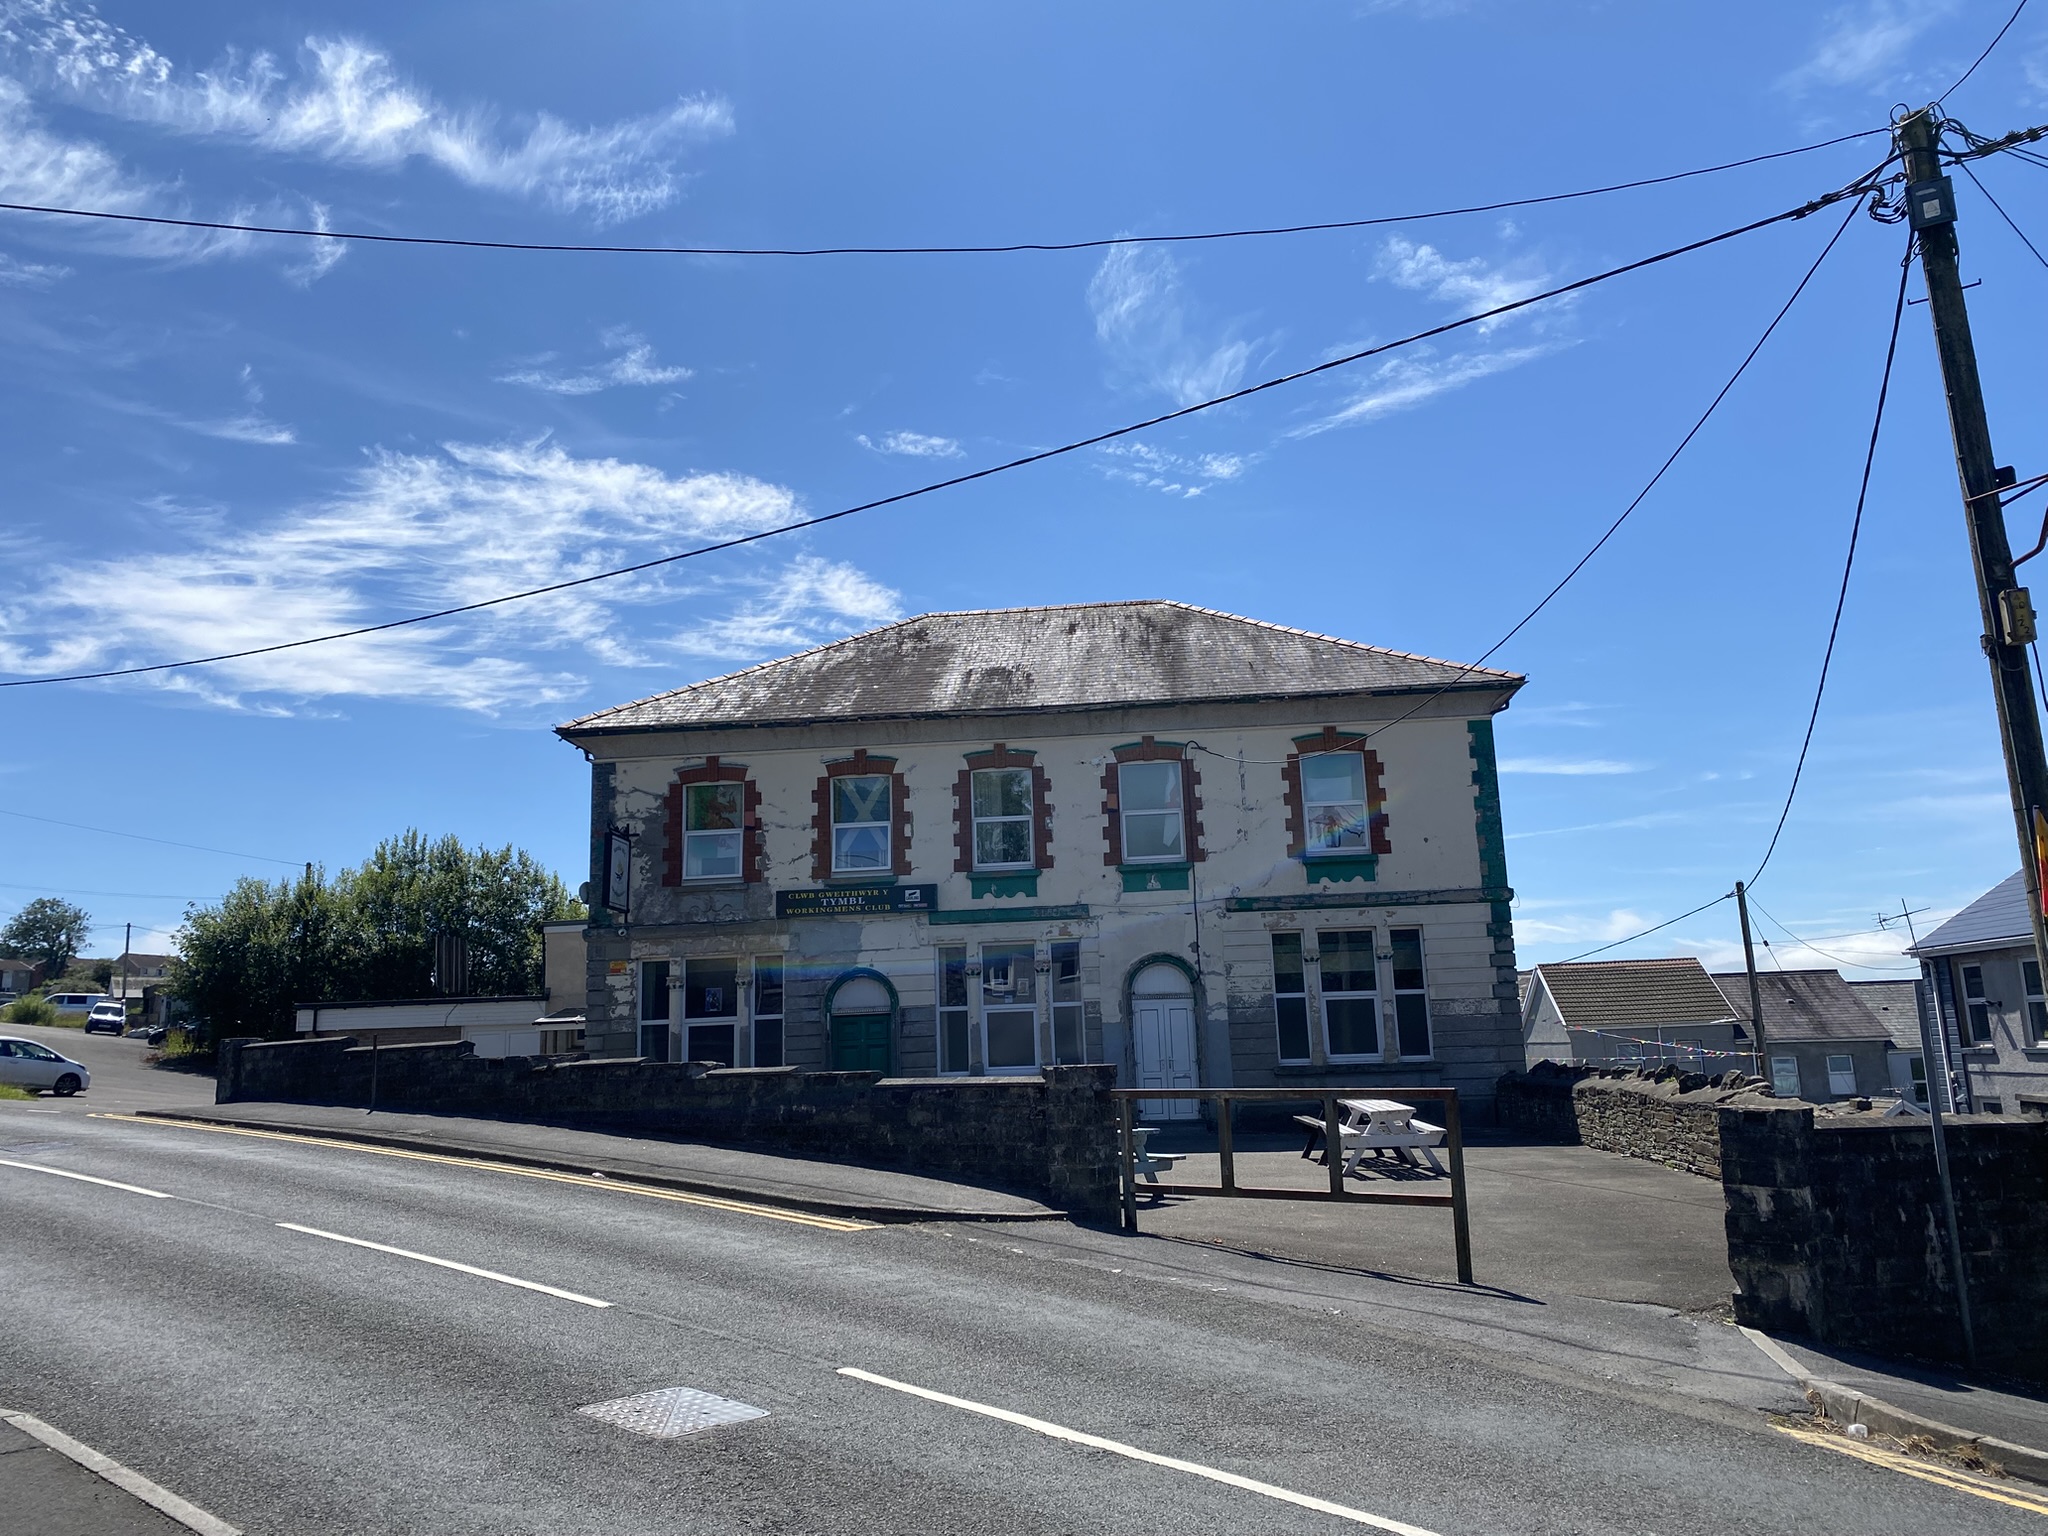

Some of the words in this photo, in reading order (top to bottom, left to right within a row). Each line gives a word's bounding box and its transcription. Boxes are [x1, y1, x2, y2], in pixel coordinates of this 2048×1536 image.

[788, 892, 815, 900] CLWB
[818, 890, 879, 899] GWEITHWYR
[820, 896, 866, 907] TYMBL
[786, 905, 862, 915] WORKINGMENS
